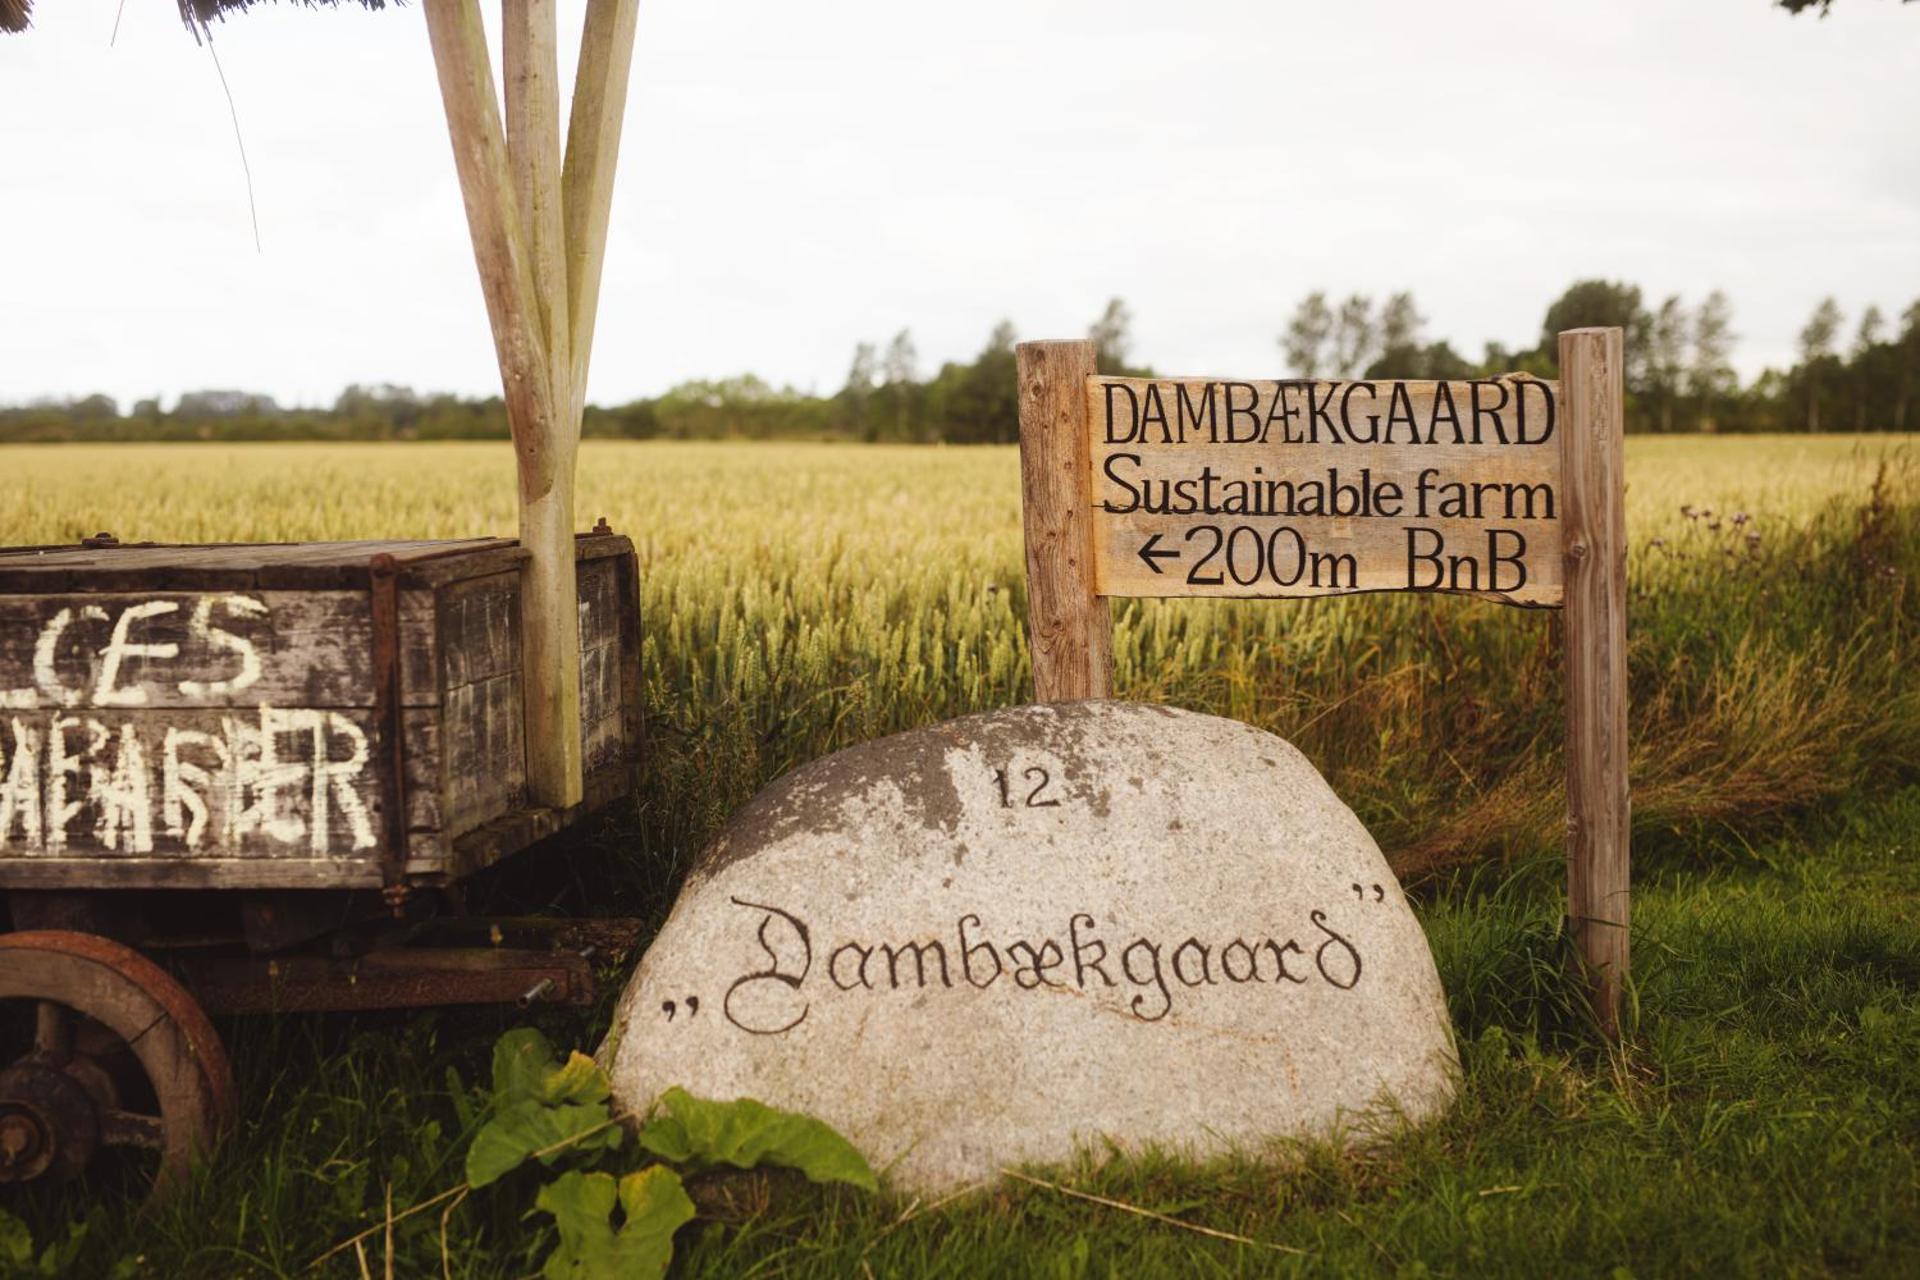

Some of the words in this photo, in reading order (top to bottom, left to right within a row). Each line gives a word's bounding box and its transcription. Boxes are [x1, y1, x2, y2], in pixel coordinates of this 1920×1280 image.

[1101, 381, 1556, 445] DAMBÆKGAARD
[1103, 453, 1404, 517] Sustainable
[1415, 468, 1557, 519] farm
[1185, 525, 1359, 589] 200m
[1402, 526, 1527, 593] BnB
[992, 766, 1061, 809] 12
